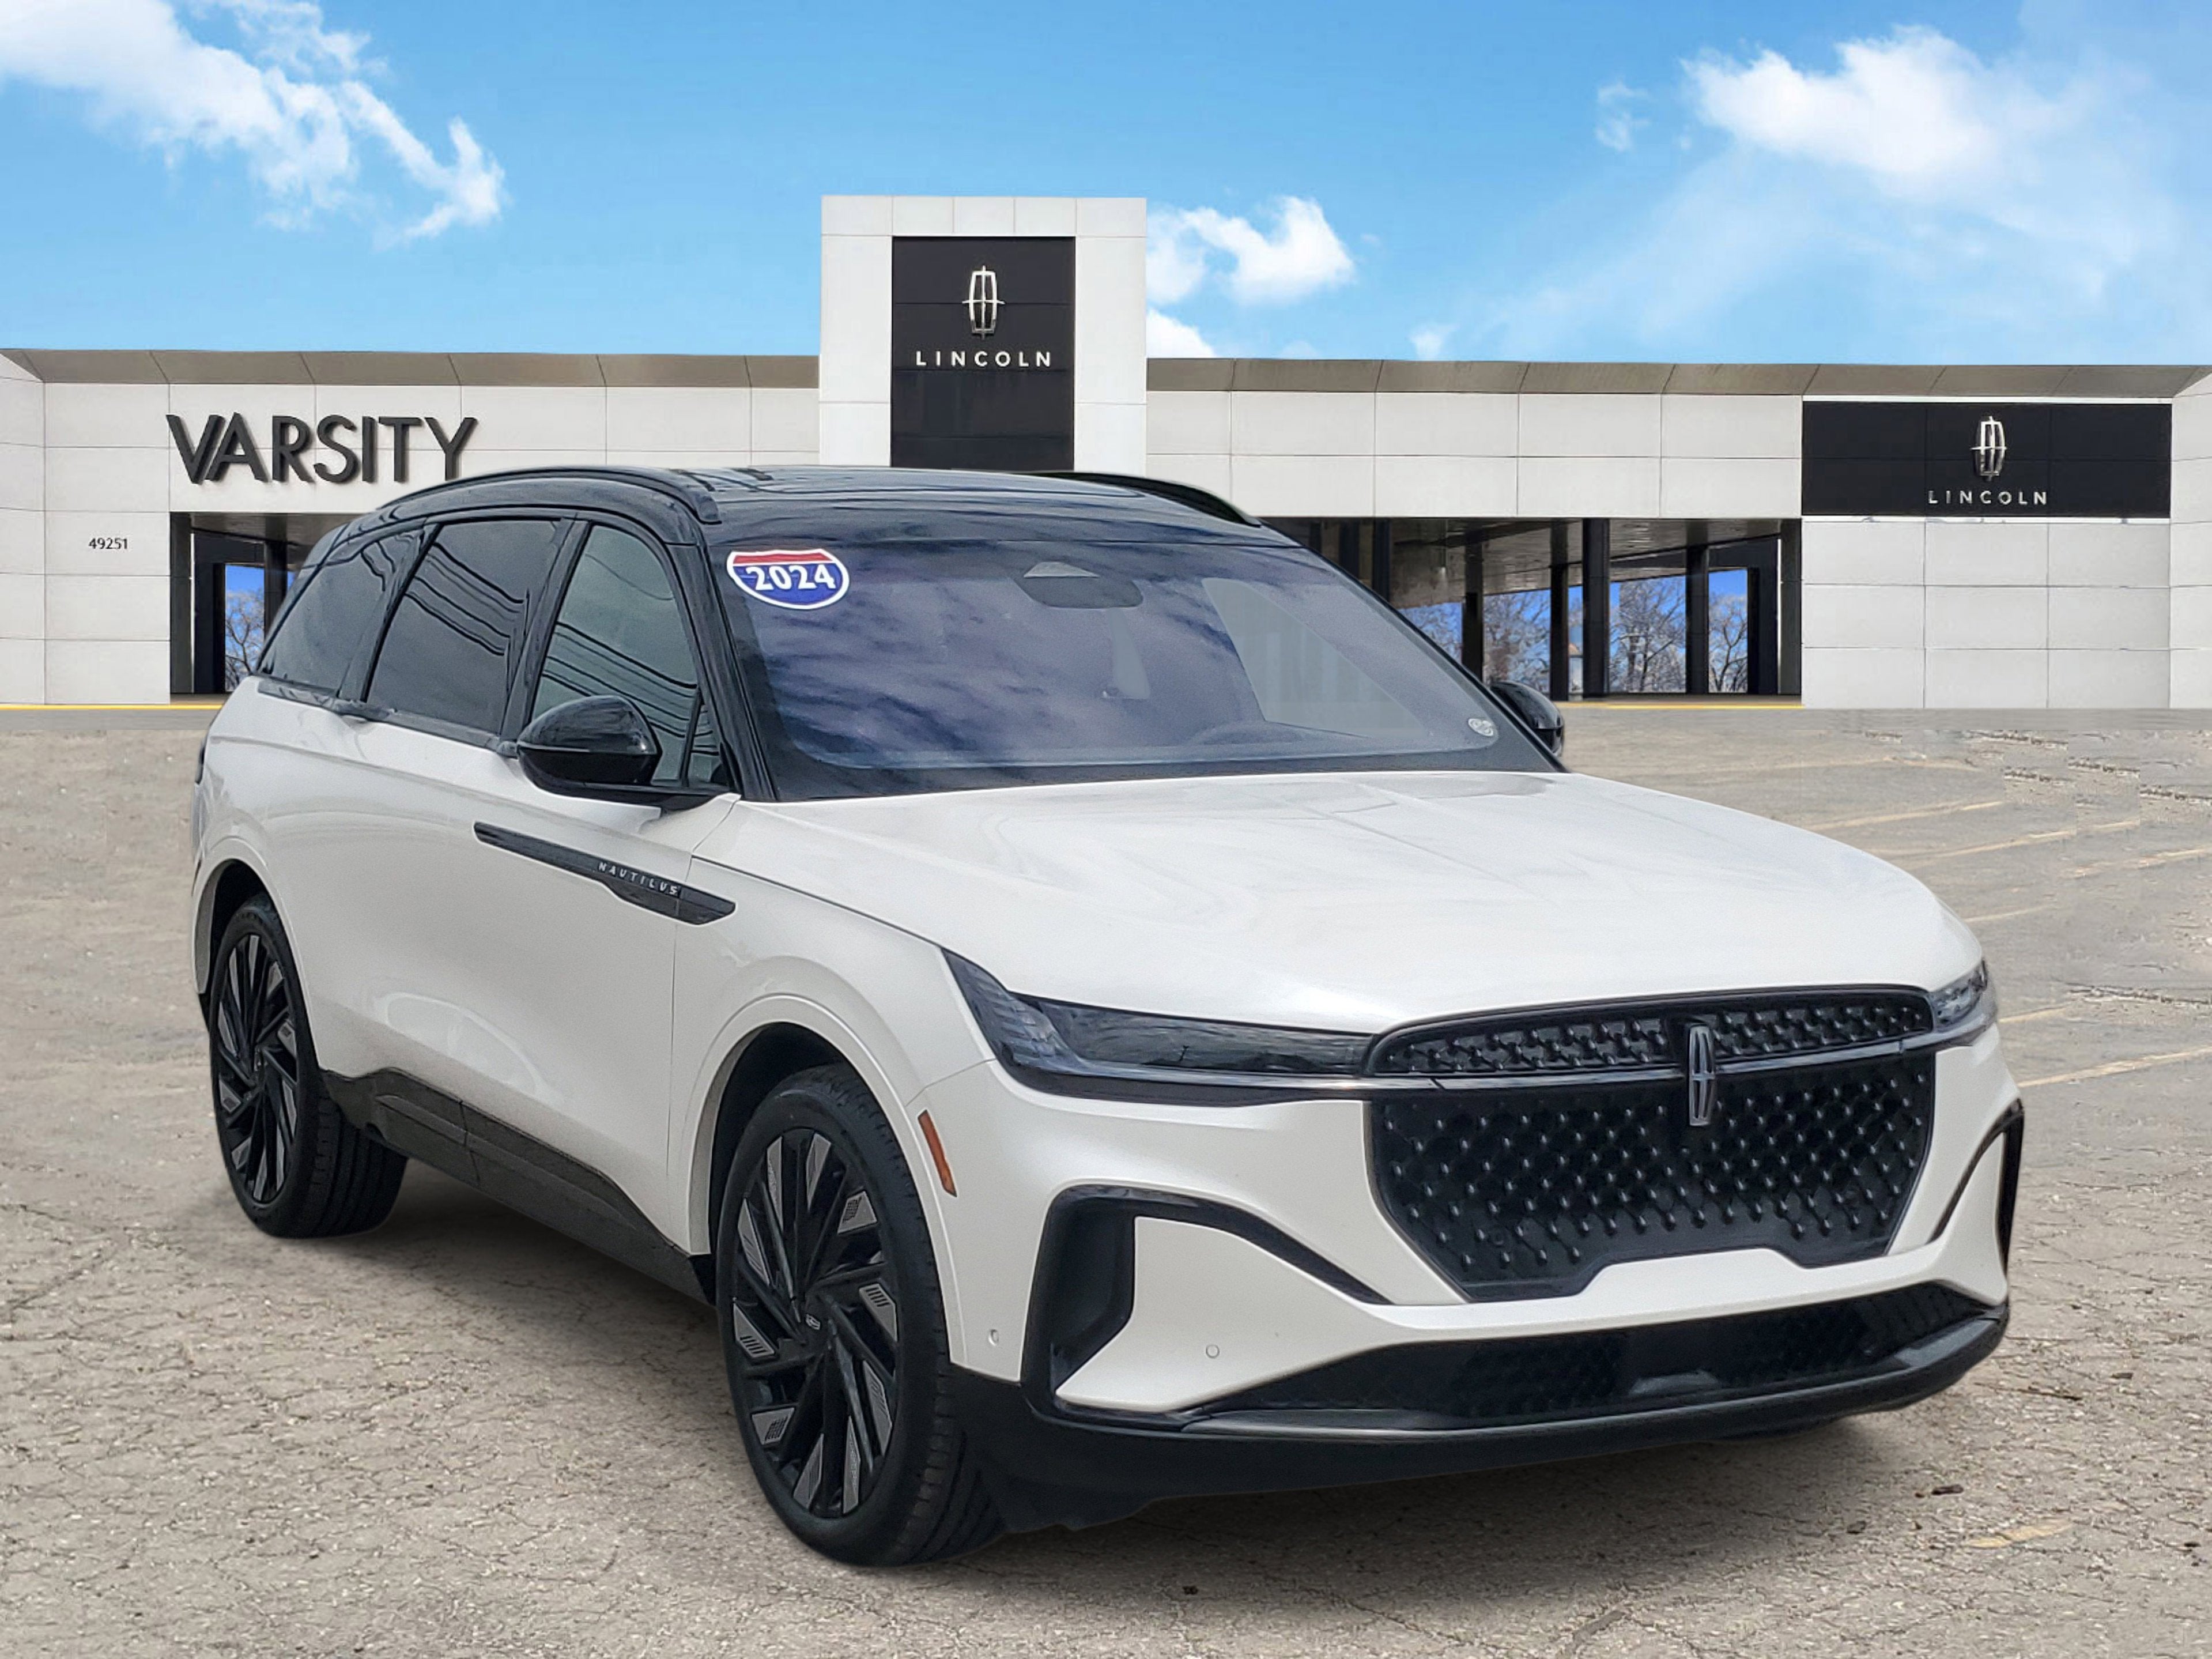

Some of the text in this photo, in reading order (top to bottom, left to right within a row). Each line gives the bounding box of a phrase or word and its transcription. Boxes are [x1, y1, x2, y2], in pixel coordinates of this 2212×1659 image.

[916, 349, 1052, 368] LINCOLN
[166, 412, 478, 484] VARSITY
[1928, 490, 2048, 505] LINCOLN
[88, 537, 128, 550] 49251
[745, 564, 836, 591] 2024
[598, 862, 678, 895] NAUTILUS
